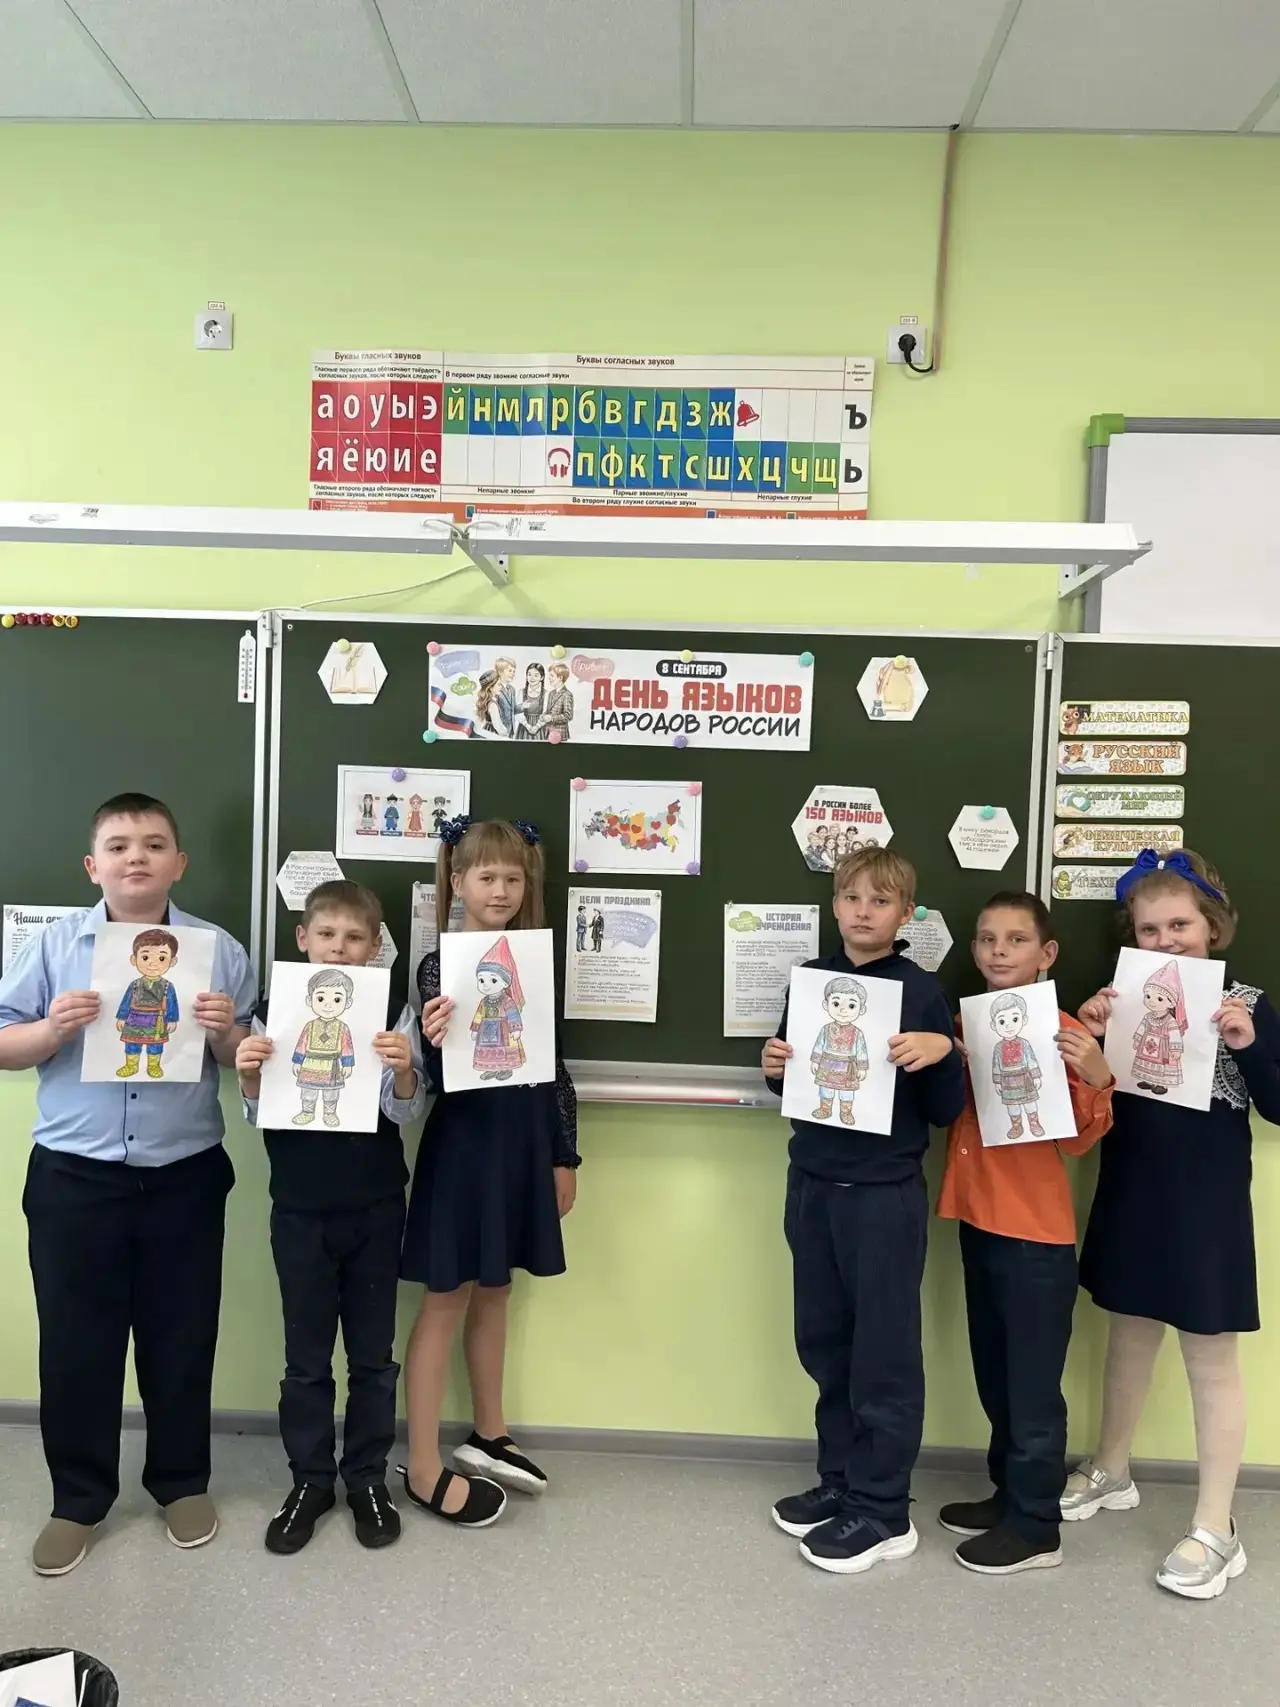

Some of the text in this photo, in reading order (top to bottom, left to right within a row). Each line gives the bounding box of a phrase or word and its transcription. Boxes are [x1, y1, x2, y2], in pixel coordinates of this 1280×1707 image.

[334, 352, 359, 361] Буквы
[576, 355, 602, 365] Буквы
[604, 357, 646, 365] согласных
[452, 371, 475, 379] первом
[477, 372, 491, 380] ряду
[551, 372, 570, 380] звуки
[317, 394, 438, 427] а о у ы э
[447, 387, 732, 432] й н м л р б в г д з ж
[317, 438, 437, 474] я ё ю и е
[576, 444, 836, 490] п ф к т с ш х ц ч щ
[662, 663, 721, 676] 8 СЕНТЯБРЯ
[591, 678, 803, 714] ДЕНЬ ЯЗЫКОВ
[1083, 711, 1189, 723] МАТЕМАТИКА
[590, 711, 801, 737] НАРОДОВ РОССИИ
[1092, 742, 1181, 758] РУССКИЙ
[1109, 760, 1164, 773] ЯЗЫК
[1087, 791, 1183, 803] ОКРУЖАЮЩИЙ
[821, 800, 847, 808] РОССИИ
[849, 802, 872, 810] БОЛЕЕ
[1120, 801, 1148, 810] МИР
[805, 806, 882, 824] 150 ЯЗЫКОВ
[1084, 830, 1180, 842] ФИЗИЧЕСКАЯ
[1093, 841, 1169, 852] КУЛЬТУРА
[579, 896, 651, 906] ЦЕЛИ ПРАЗДНИКА
[13, 911, 44, 925] Наши
[766, 912, 802, 921] ИСТОРИЯ
[757, 922, 812, 931] УЧРЕЖДЕНИЯ
